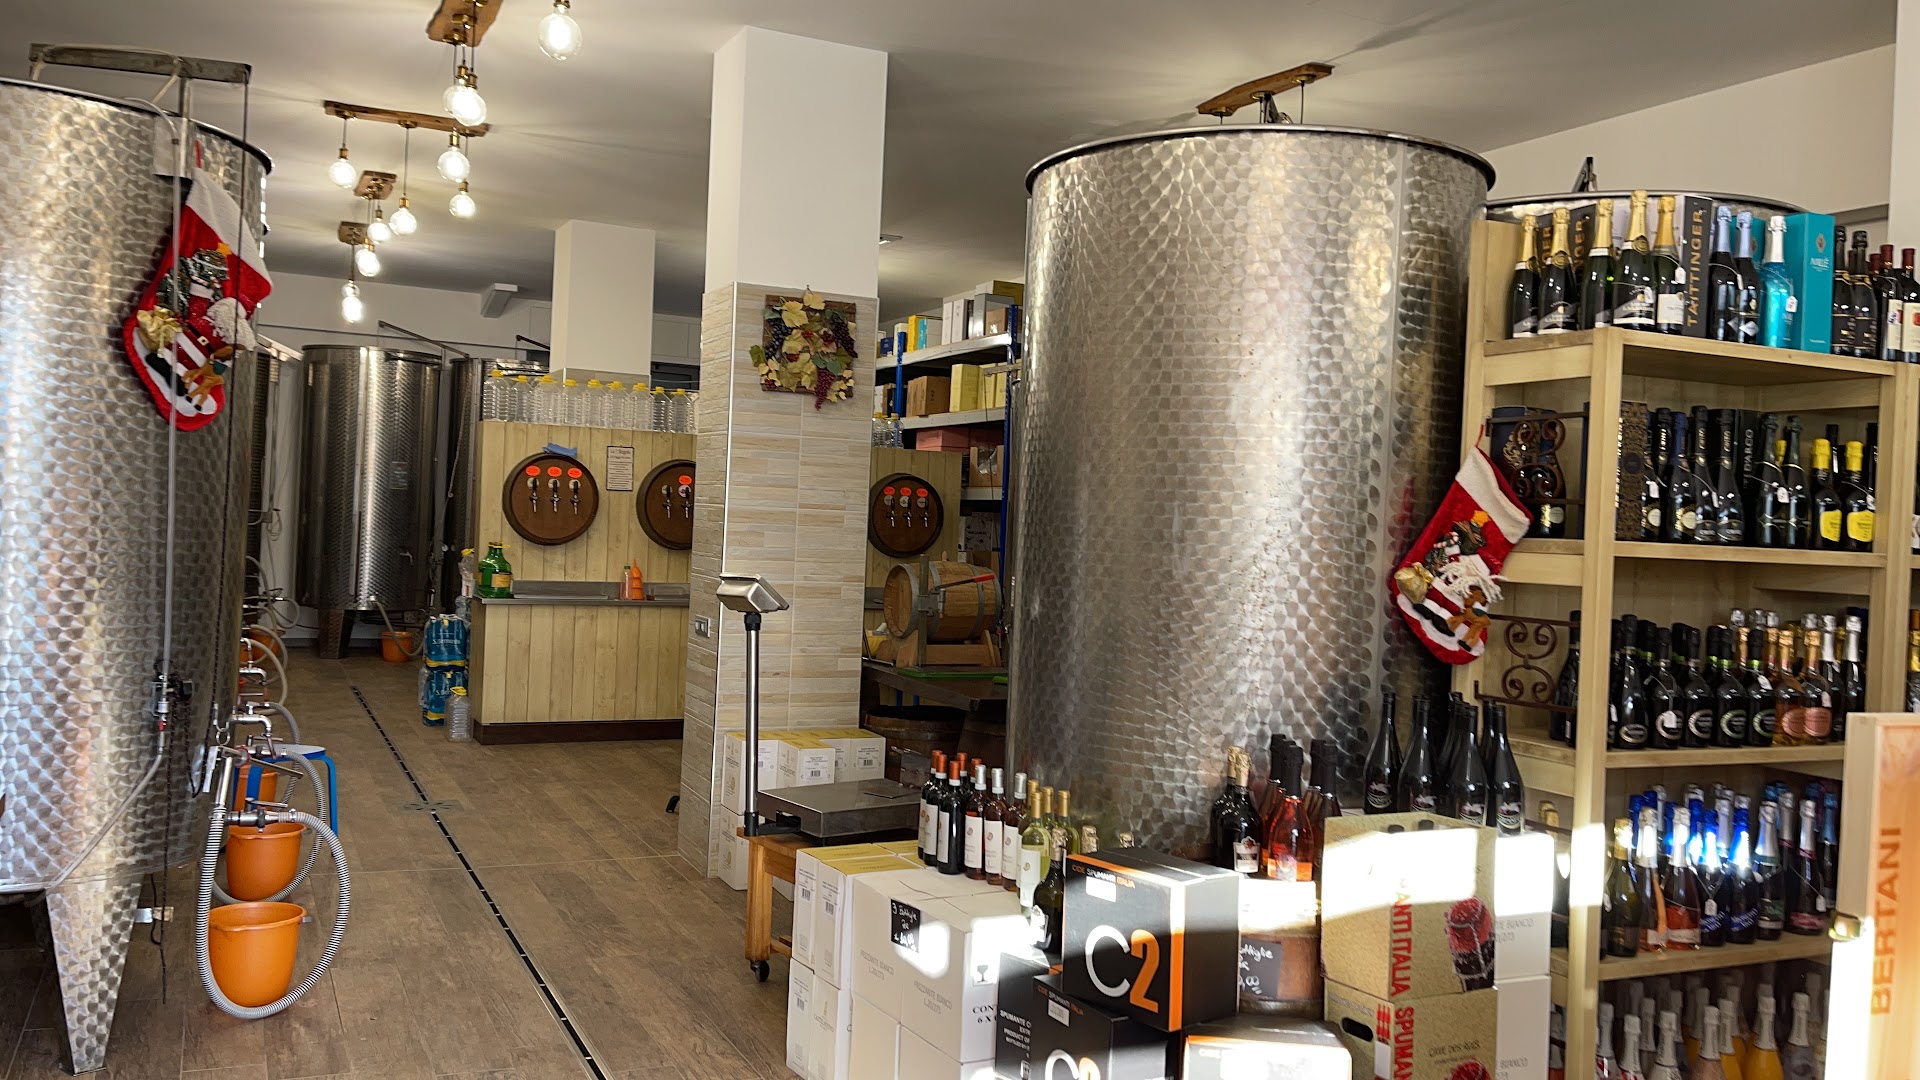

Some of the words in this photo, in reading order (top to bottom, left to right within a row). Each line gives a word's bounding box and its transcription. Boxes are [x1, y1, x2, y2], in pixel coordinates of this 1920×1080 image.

[1687, 210, 1704, 327] TAITTINGER
[1392, 891, 1412, 934] ANTI
[1870, 827, 1901, 1016] BERTANI
[1085, 924, 1161, 1013] C2
[1391, 937, 1412, 997] ITALIA
[1020, 1026, 1031, 1036] EXTR
